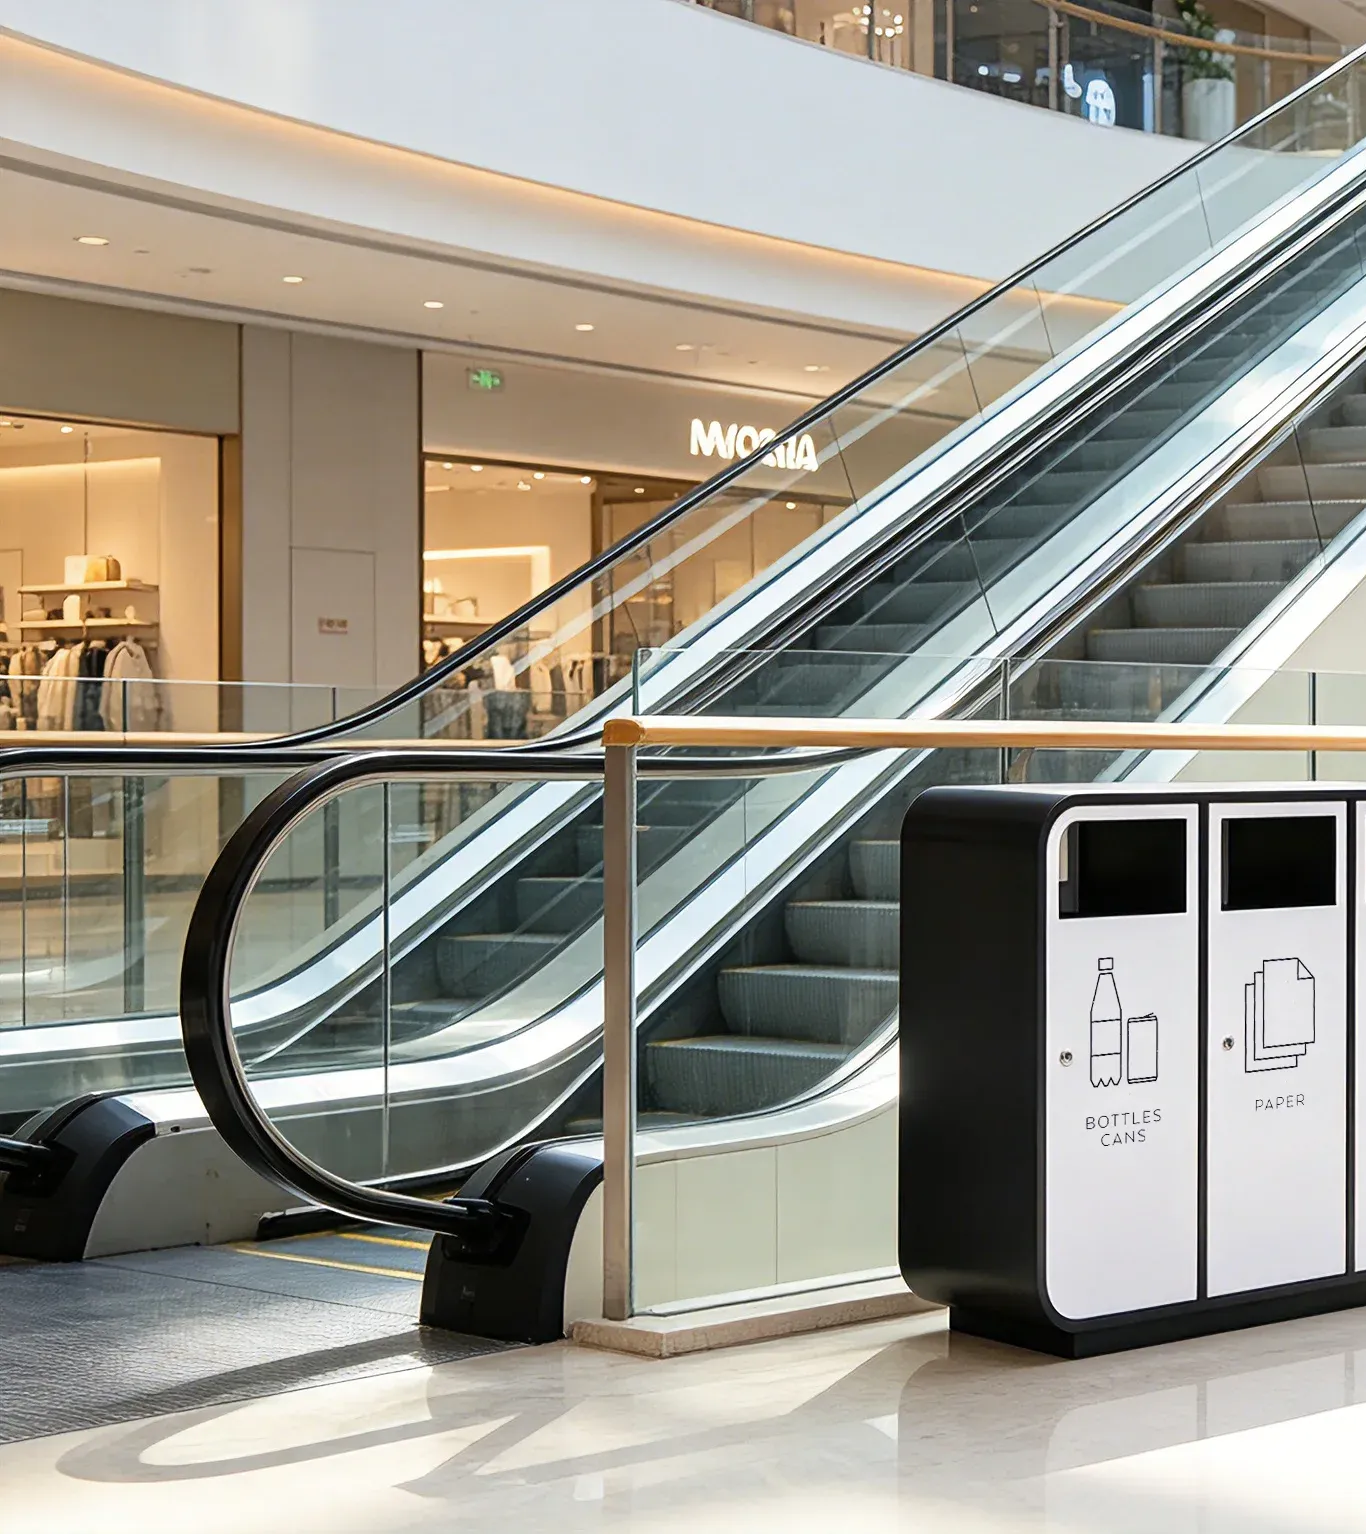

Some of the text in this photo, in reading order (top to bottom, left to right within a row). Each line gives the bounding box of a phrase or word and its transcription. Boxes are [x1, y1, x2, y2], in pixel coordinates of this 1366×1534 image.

[1255, 1093, 1306, 1112] PAPER
[1085, 1108, 1162, 1130] BOTTLES
[1100, 1128, 1146, 1147] CANS
